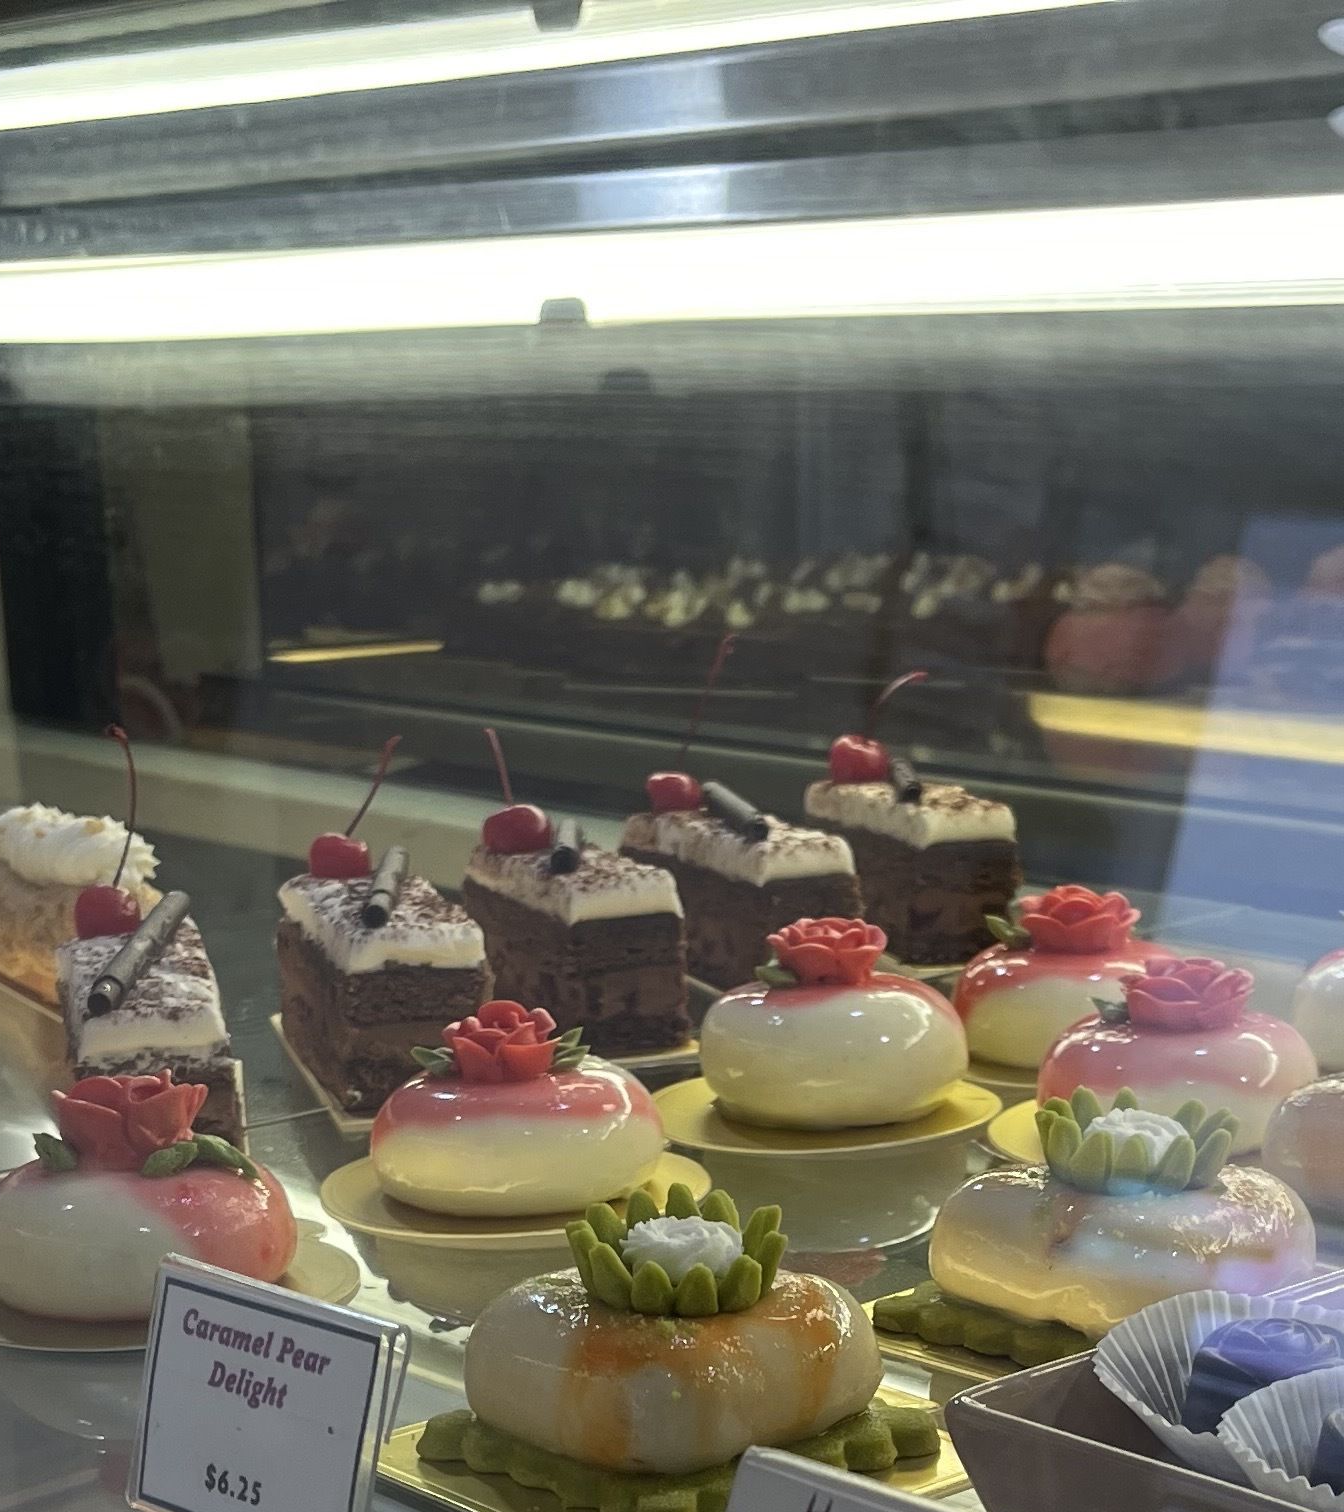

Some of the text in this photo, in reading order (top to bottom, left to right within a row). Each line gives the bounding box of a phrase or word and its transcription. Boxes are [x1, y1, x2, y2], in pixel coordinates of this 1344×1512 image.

[181, 1308, 331, 1375] Caramel Pear
[207, 1360, 288, 1409] Delight
[204, 1463, 262, 1506] $6.25
